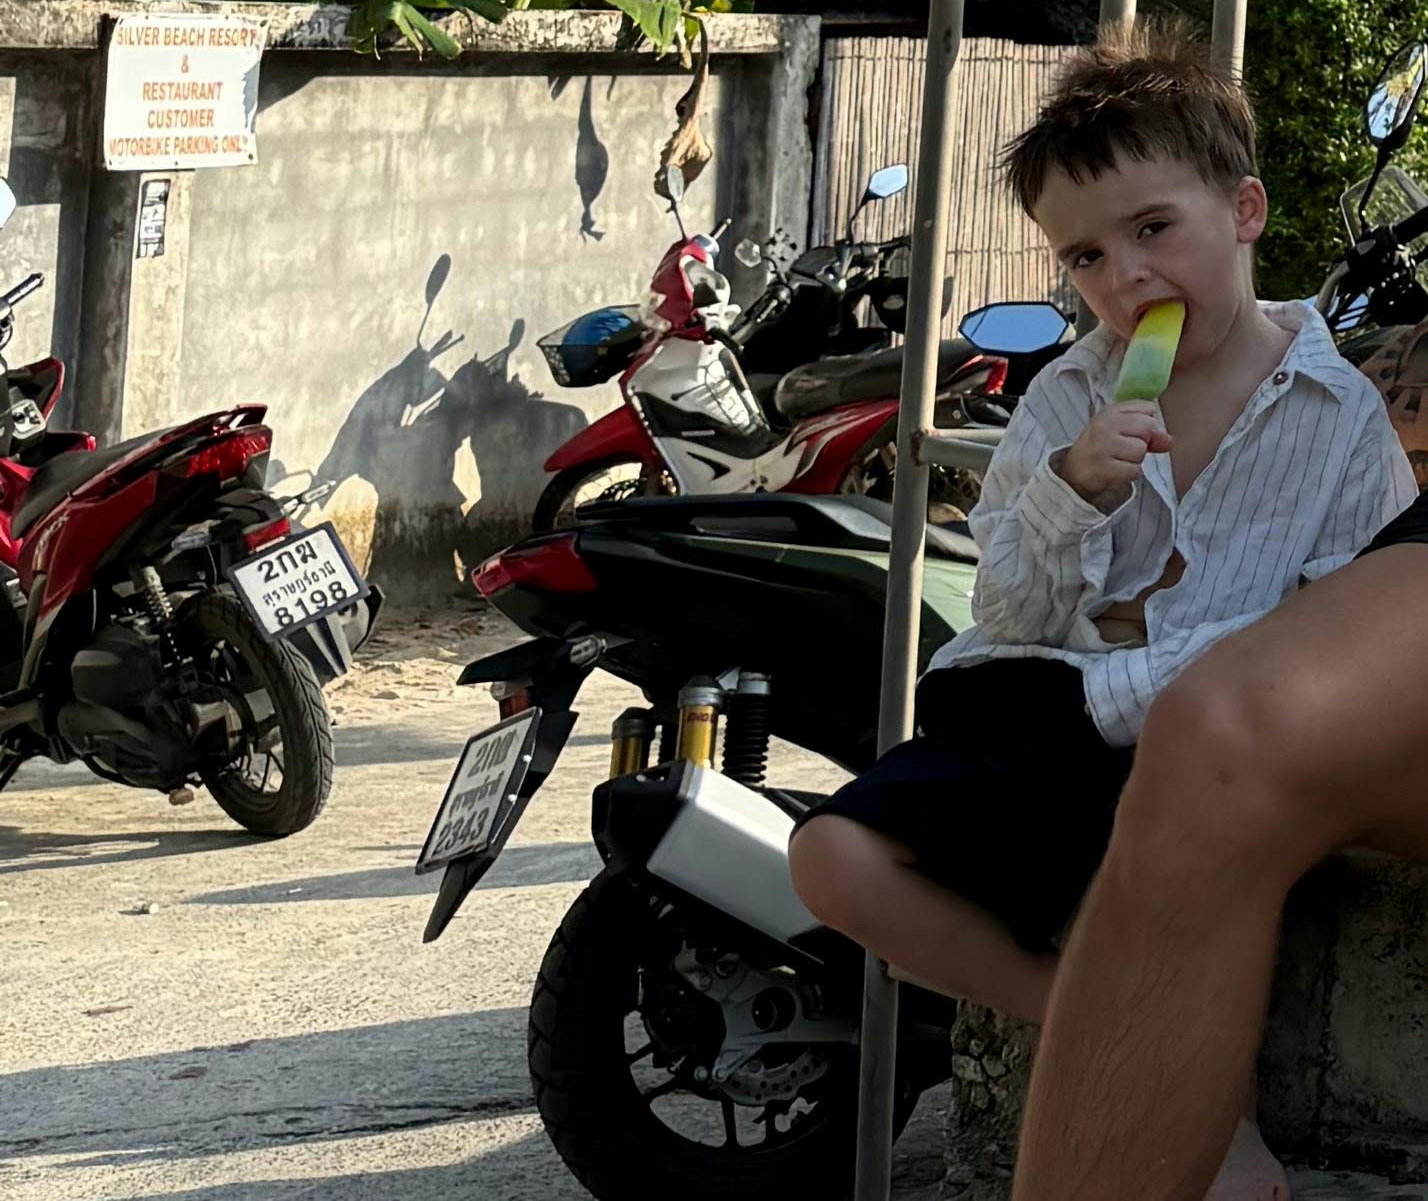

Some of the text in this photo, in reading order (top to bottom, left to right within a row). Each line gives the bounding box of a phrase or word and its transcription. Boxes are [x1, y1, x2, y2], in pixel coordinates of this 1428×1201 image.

[116, 26, 160, 46] SILVER
[163, 27, 205, 46] BEACH
[180, 54, 190, 74] &
[143, 82, 223, 101] RESTAURANT
[147, 109, 215, 128] CUSTOMER
[173, 136, 219, 155] PARKING
[274, 581, 349, 627] 8198
[432, 806, 490, 855] 2343
